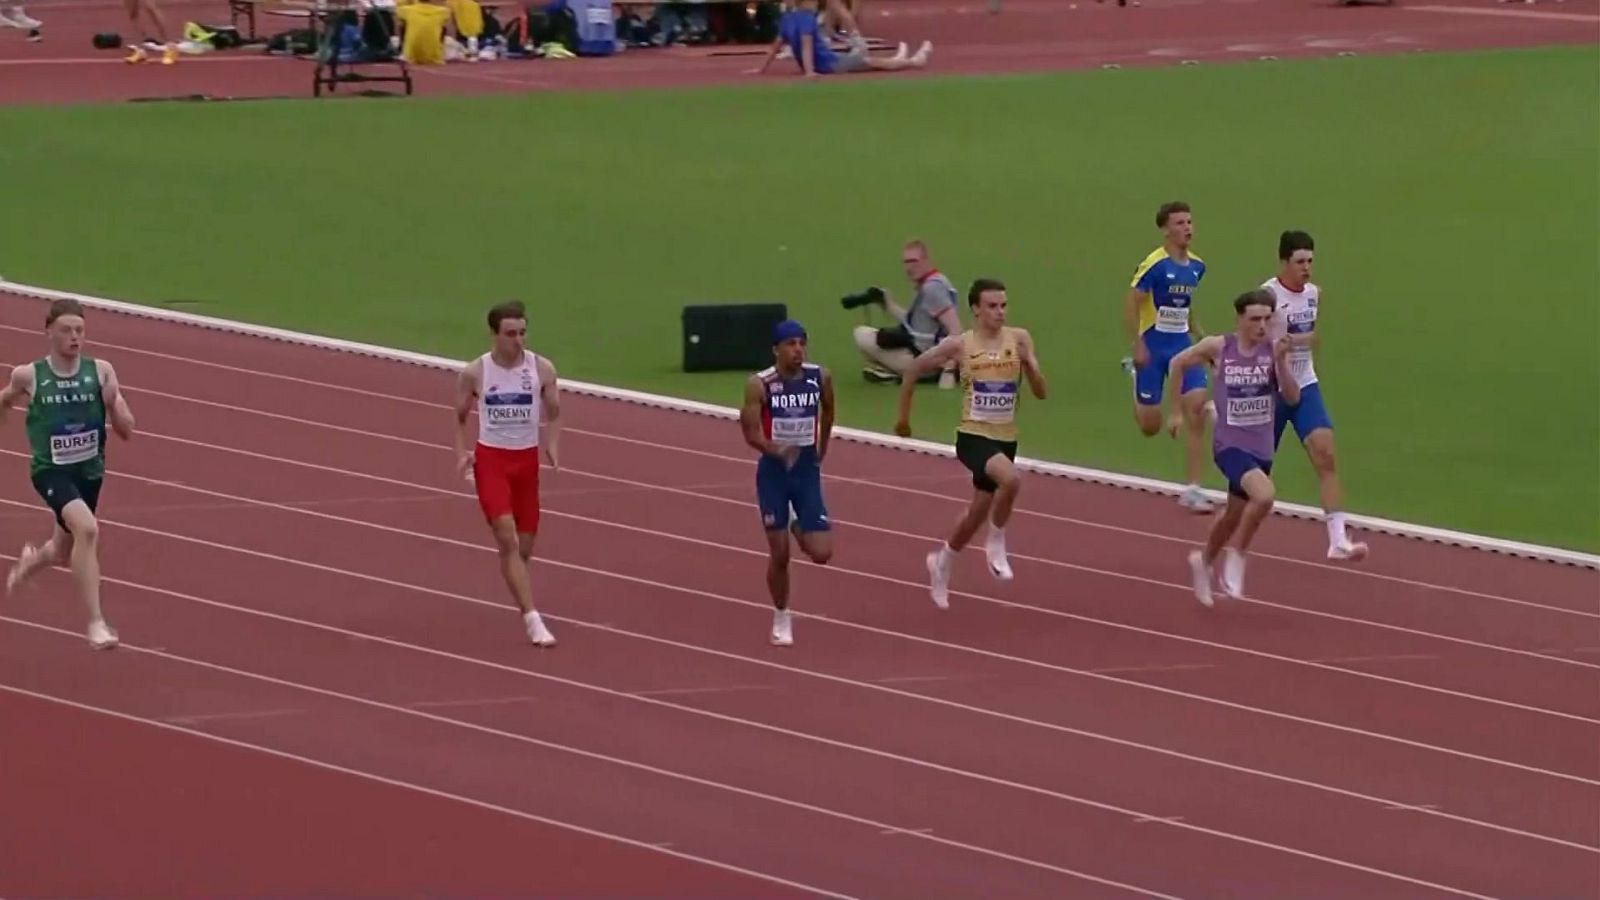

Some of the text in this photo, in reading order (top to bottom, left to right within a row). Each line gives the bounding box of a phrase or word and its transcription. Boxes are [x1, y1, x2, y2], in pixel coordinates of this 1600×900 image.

[1225, 366, 1269, 375] GREAT
[1225, 375, 1269, 385] BRITAIN
[41, 393, 96, 403] IRELAND
[772, 391, 820, 408] NORWAY
[975, 396, 1014, 407] STROH
[1230, 399, 1269, 412] TUGWELL
[488, 408, 531, 419] FOREMNY
[53, 432, 96, 450] BURKE
